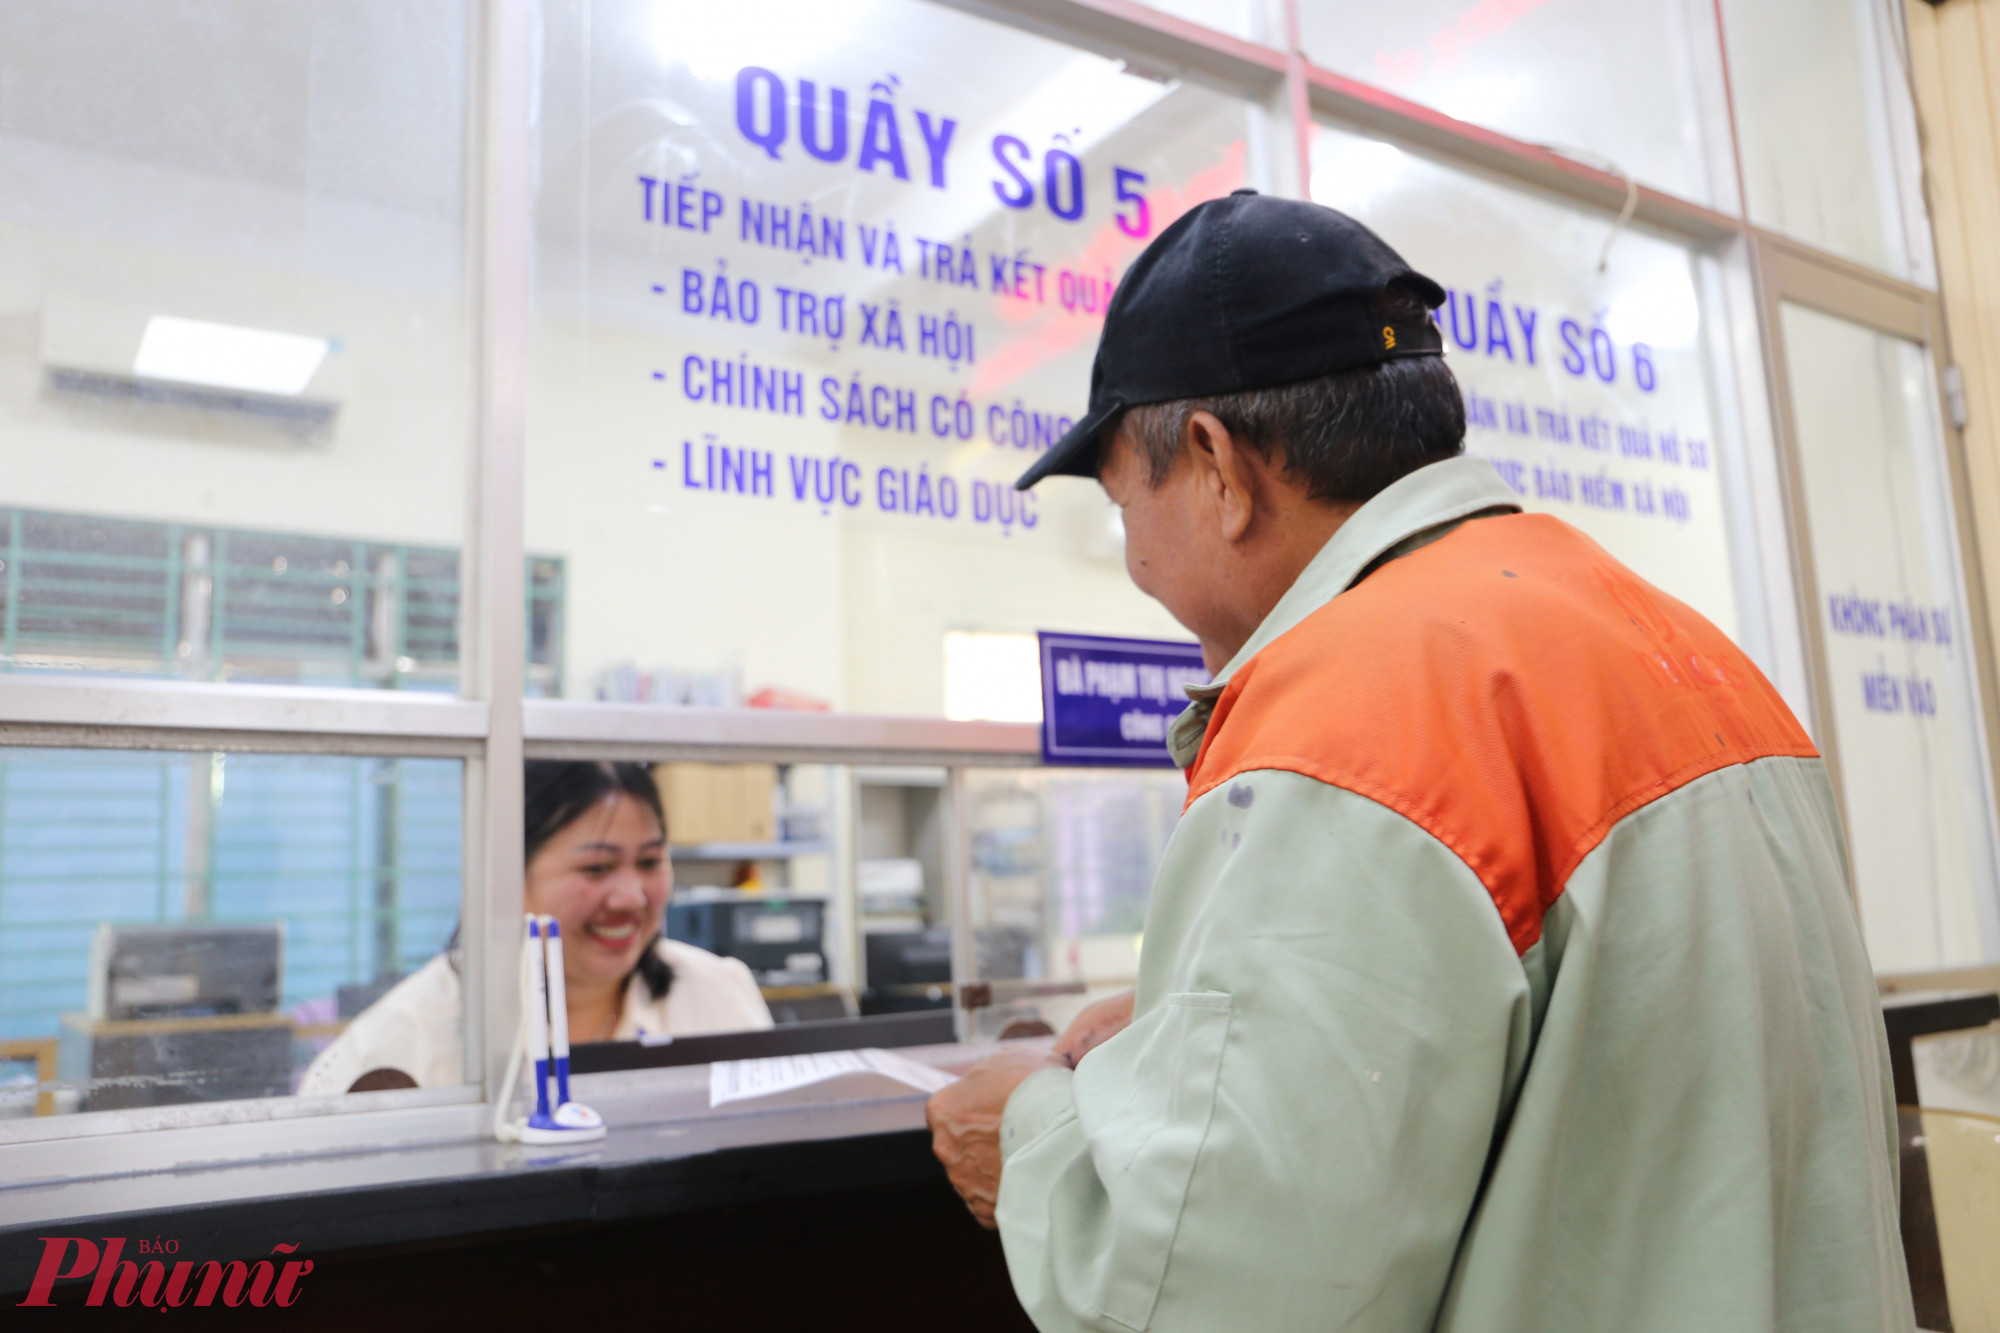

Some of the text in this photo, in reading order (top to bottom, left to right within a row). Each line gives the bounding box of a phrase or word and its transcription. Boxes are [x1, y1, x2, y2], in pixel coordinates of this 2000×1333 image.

[736, 66, 1150, 239] QUẦY SỐ 5
[638, 171, 723, 234] TIẾP
[740, 200, 845, 266] NHẬN
[859, 221, 905, 275] VÀ
[916, 238, 980, 290] TRẢ
[990, 246, 1044, 304] KẾT
[682, 259, 760, 325] BẢO
[776, 286, 845, 350] TRỢ
[859, 299, 907, 352] XÃ
[919, 311, 975, 372] HỘI
[1561, 305, 1616, 383] SỐ
[1633, 340, 1656, 393] 6
[682, 352, 805, 416] CHÍNH
[820, 372, 917, 433] SÁCH
[932, 388, 974, 441] CÓ
[683, 432, 774, 498] LĨNH
[789, 453, 862, 517] VỰC
[877, 461, 958, 520] GIÁO
[973, 480, 1038, 537] DỤC
